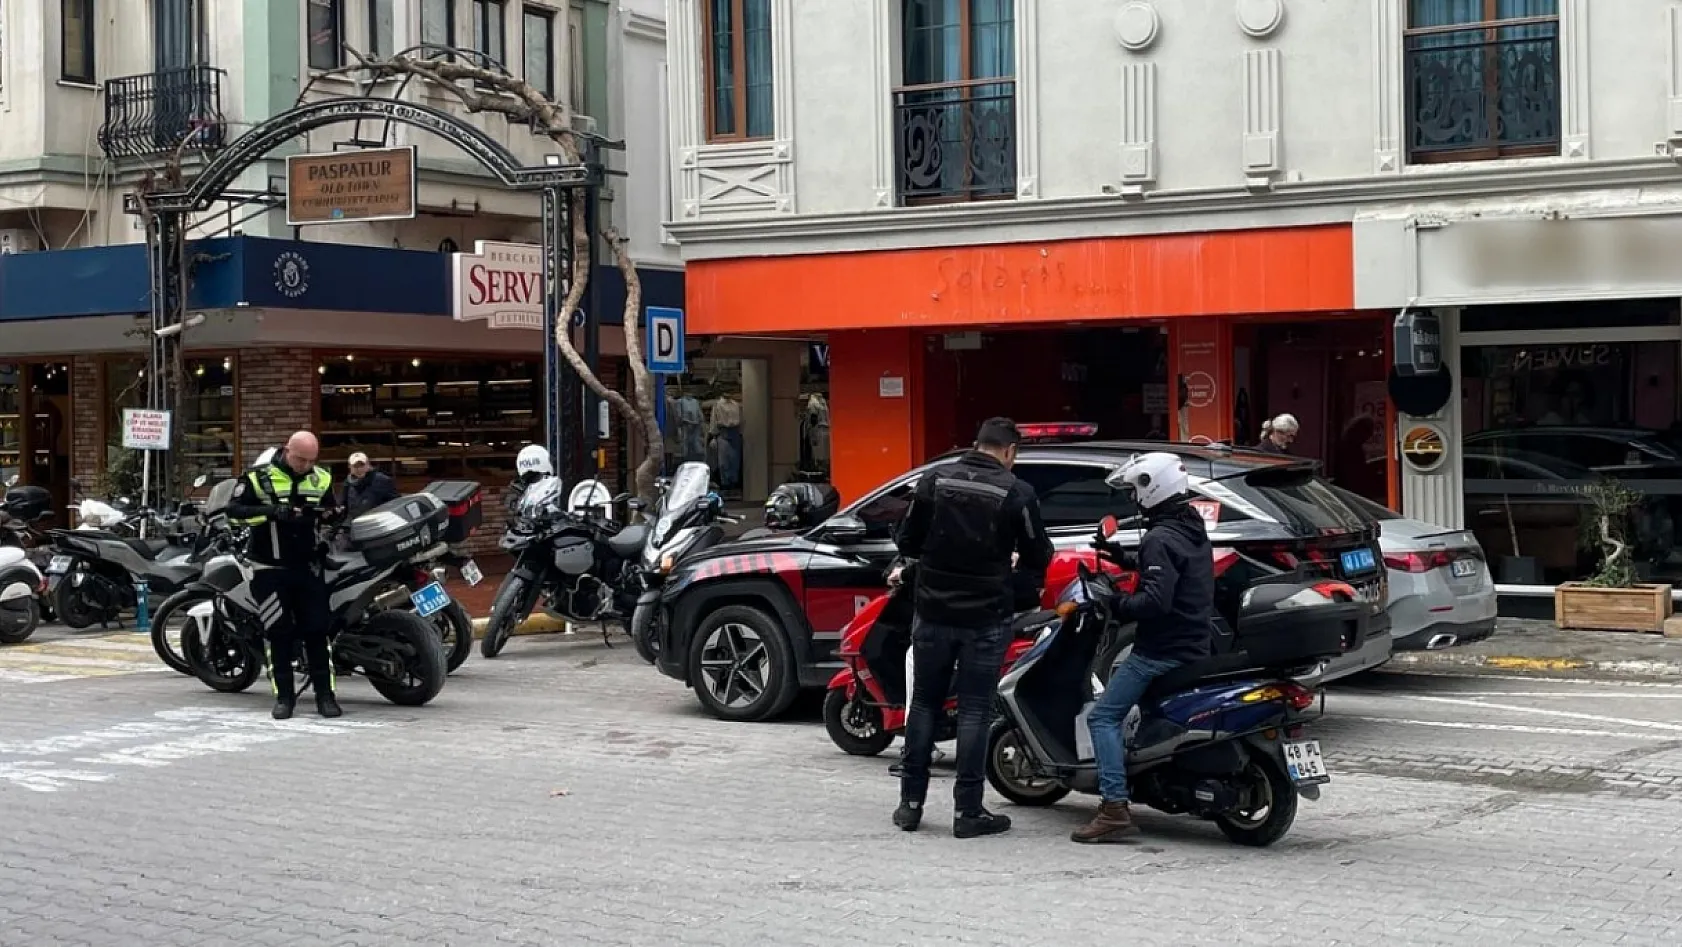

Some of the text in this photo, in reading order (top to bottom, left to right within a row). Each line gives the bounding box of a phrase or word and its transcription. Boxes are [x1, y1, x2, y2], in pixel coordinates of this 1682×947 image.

[309, 160, 391, 180] PASPATUR
[320, 183, 344, 194] OLD
[657, 322, 674, 357] D
[1288, 743, 1320, 760] 48 PL
[1297, 760, 1318, 776] 845
